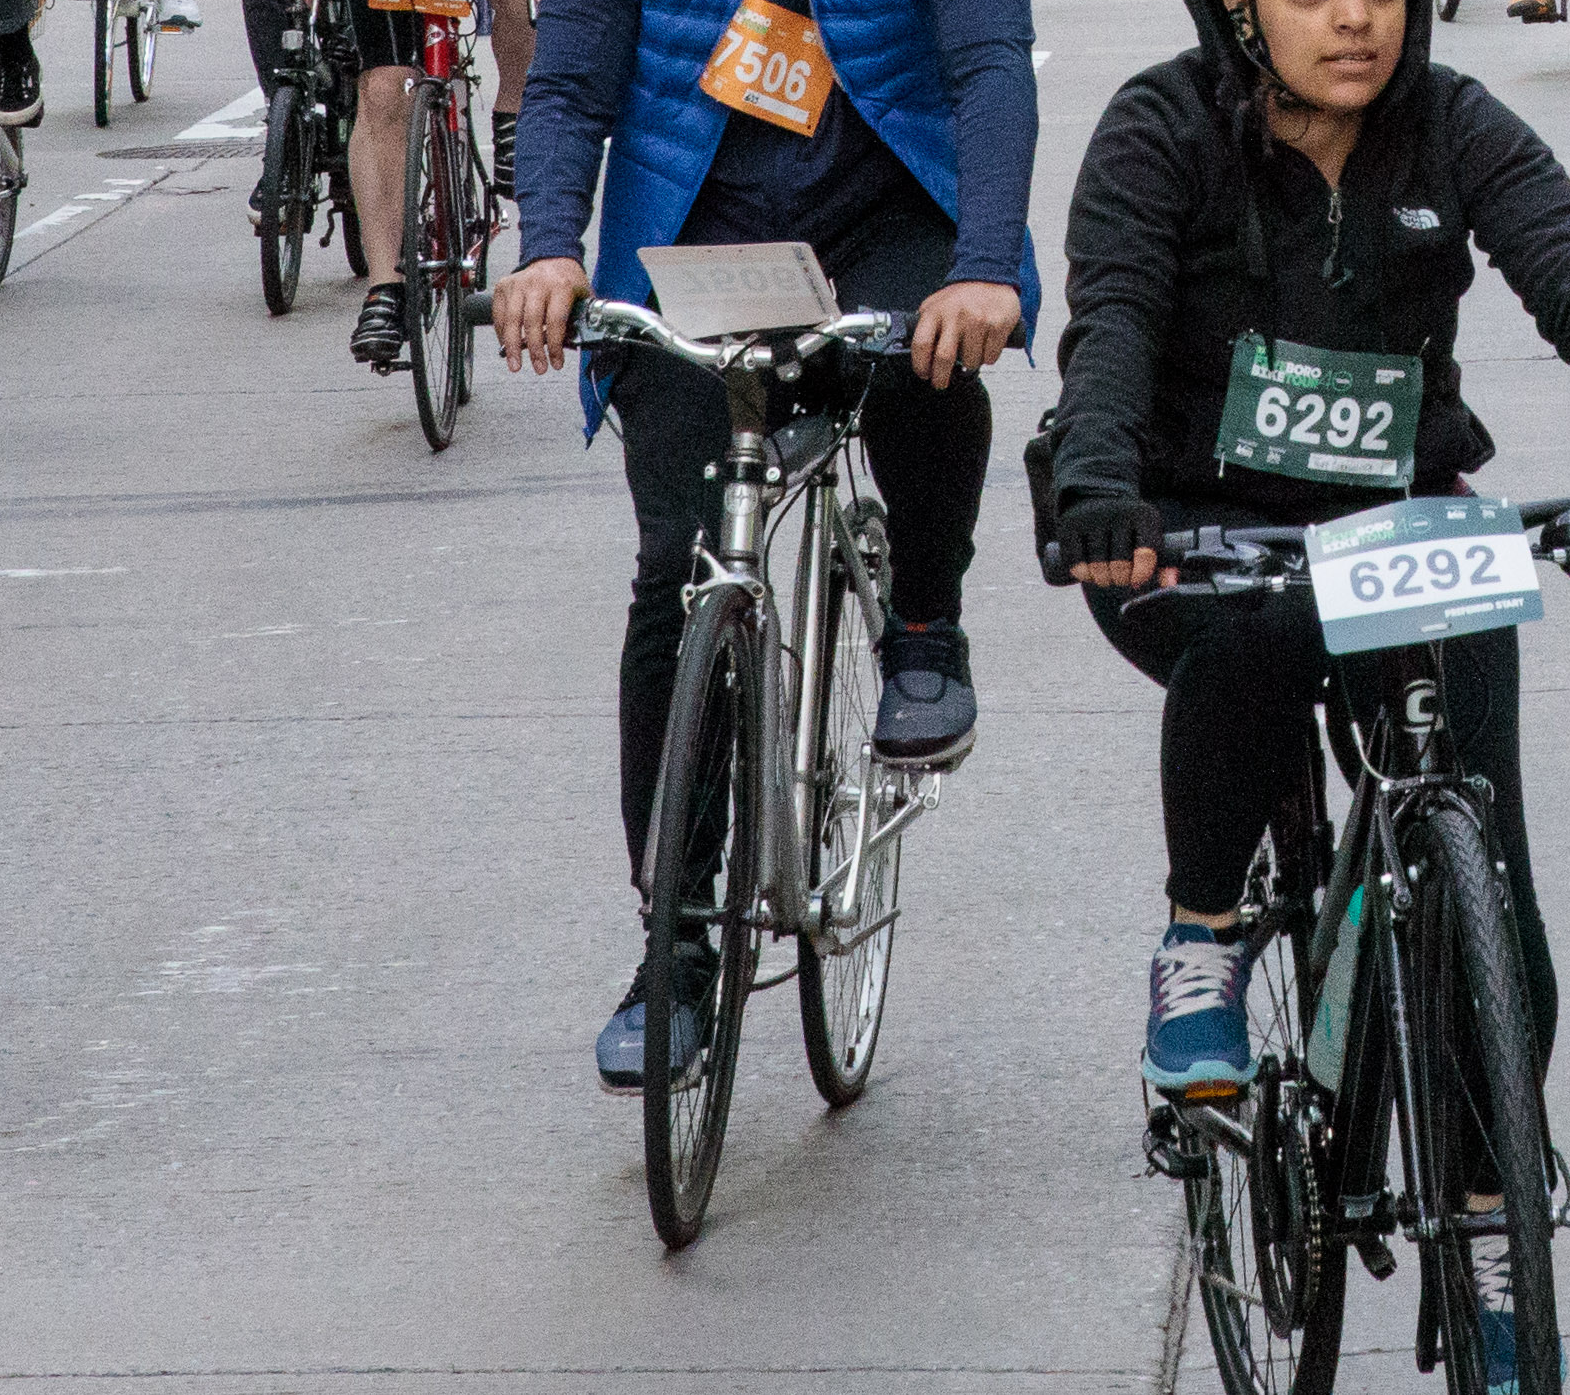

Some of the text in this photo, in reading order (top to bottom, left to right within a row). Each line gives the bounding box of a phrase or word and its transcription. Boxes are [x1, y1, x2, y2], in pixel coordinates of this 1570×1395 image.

[713, 27, 813, 103] 7506
[1255, 386, 1395, 452] 6292
[1348, 544, 1502, 604] 6292
